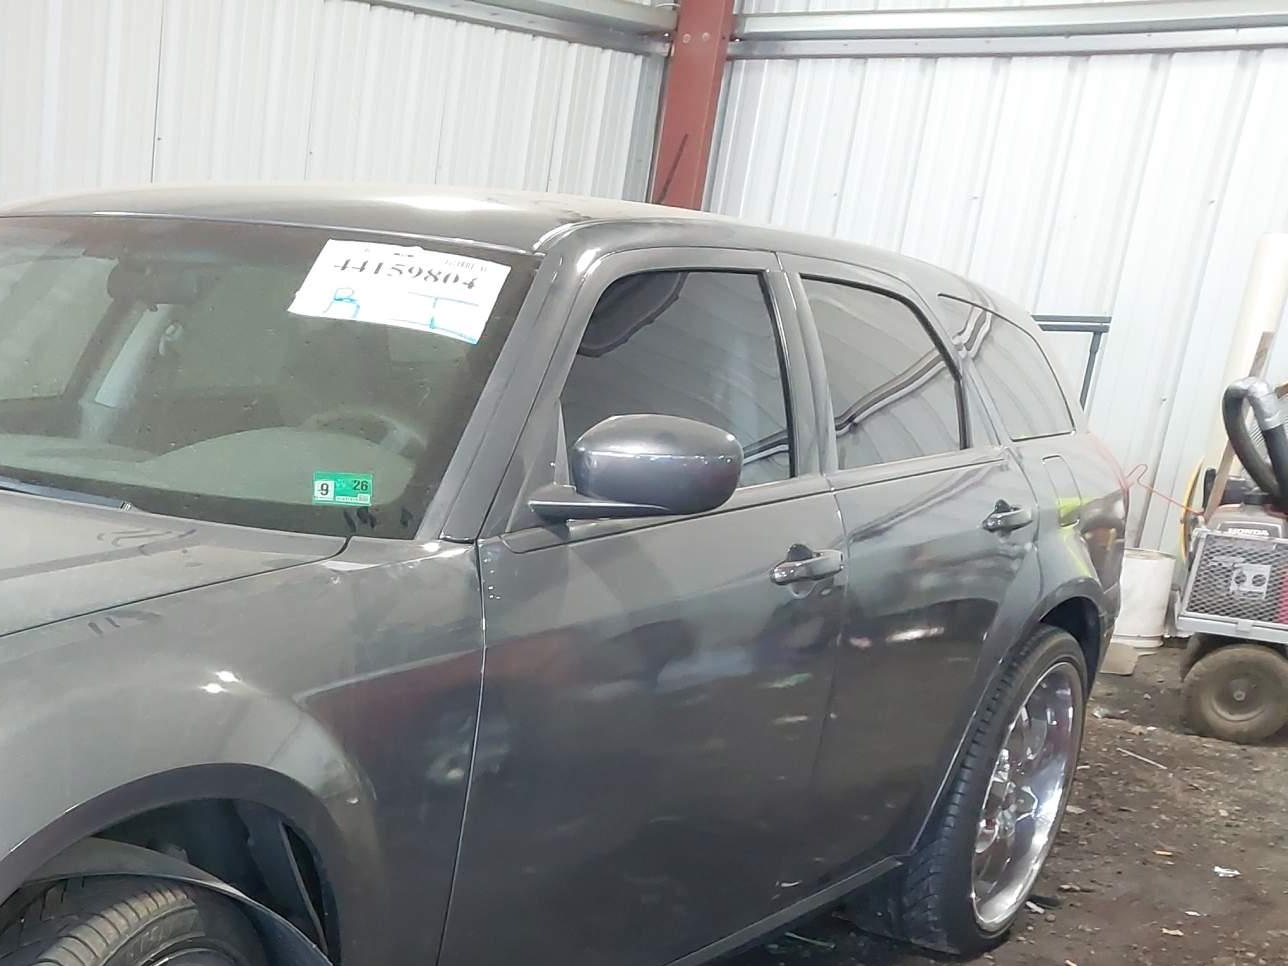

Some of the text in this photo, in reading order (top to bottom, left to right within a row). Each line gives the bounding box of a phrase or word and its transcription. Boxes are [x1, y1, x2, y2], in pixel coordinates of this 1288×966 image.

[333, 257, 479, 290] 44159804
[320, 483, 329, 496] 9
[352, 479, 369, 491] 26
[1227, 527, 1270, 536] HONDA
